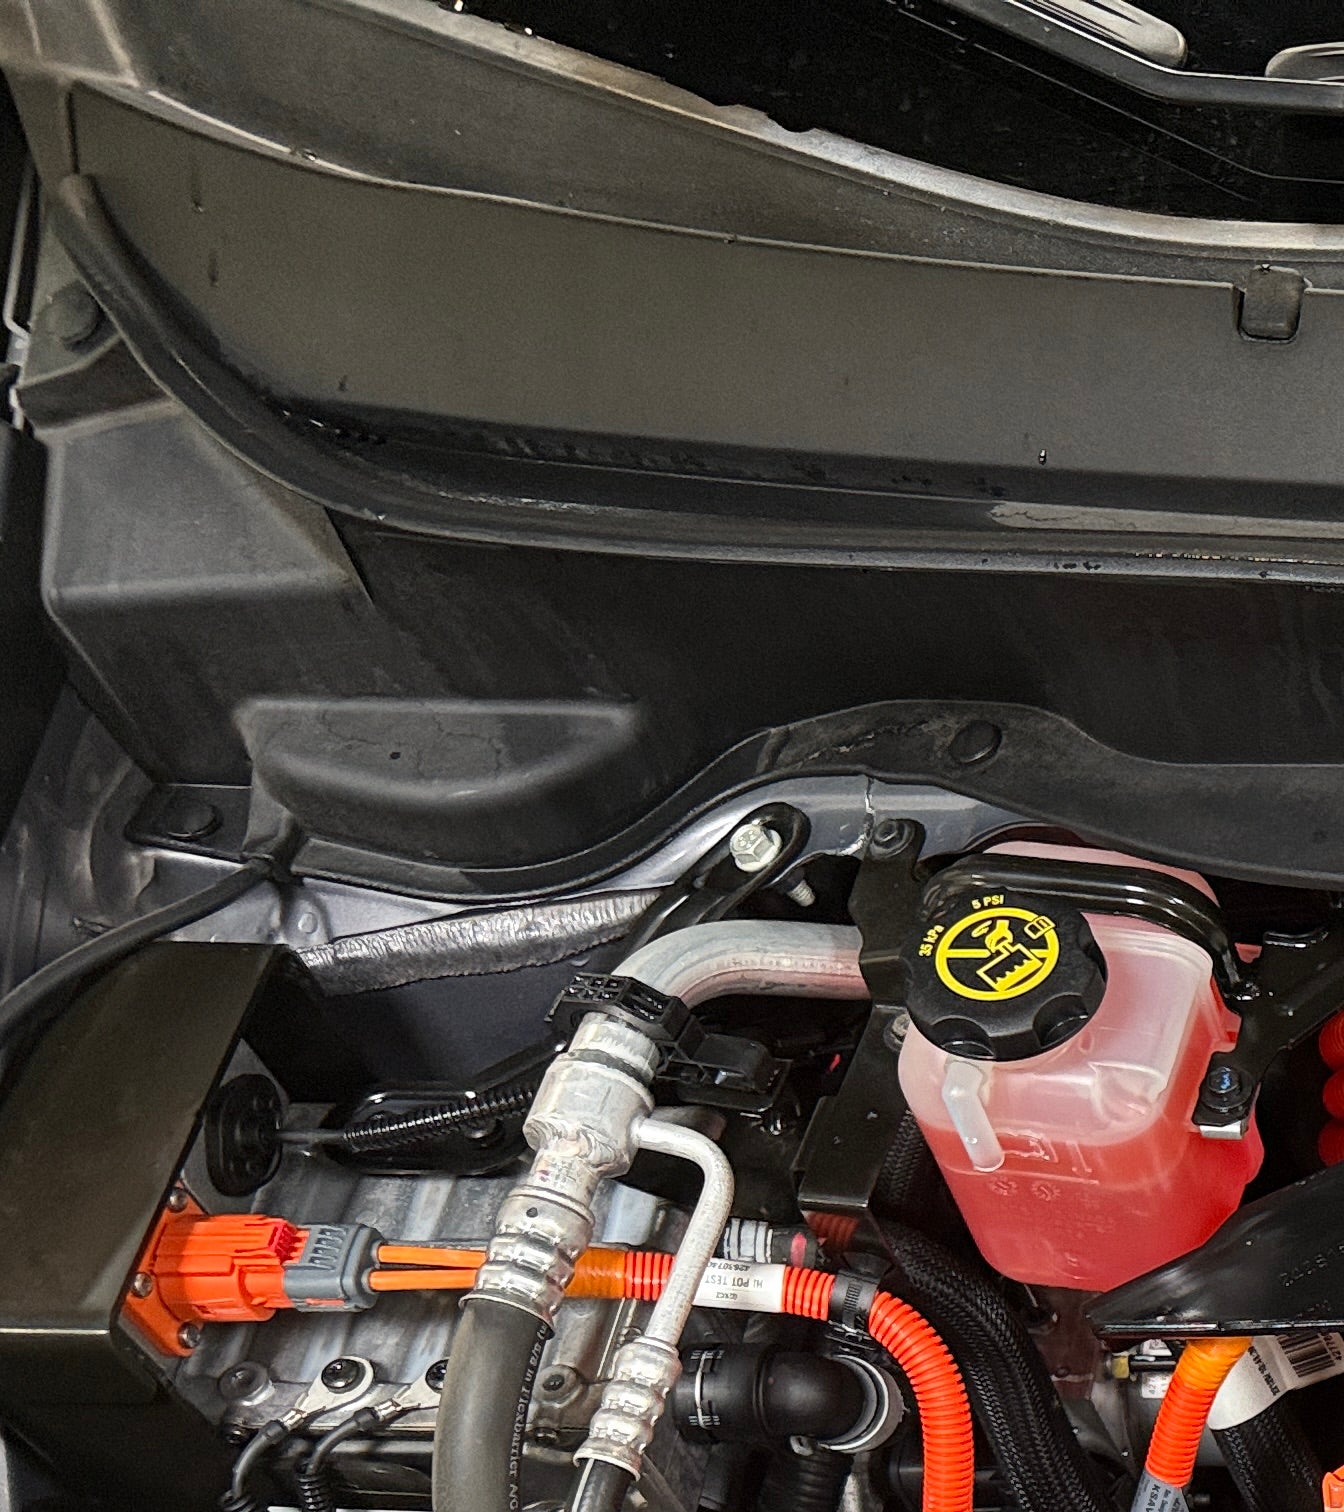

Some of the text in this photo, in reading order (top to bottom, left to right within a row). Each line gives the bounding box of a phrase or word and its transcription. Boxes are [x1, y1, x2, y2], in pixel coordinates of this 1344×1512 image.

[971, 894, 1004, 909] 5 PSI
[923, 924, 945, 943] kPa
[704, 1274, 728, 1286] TEST
[731, 1277, 750, 1288] POT
